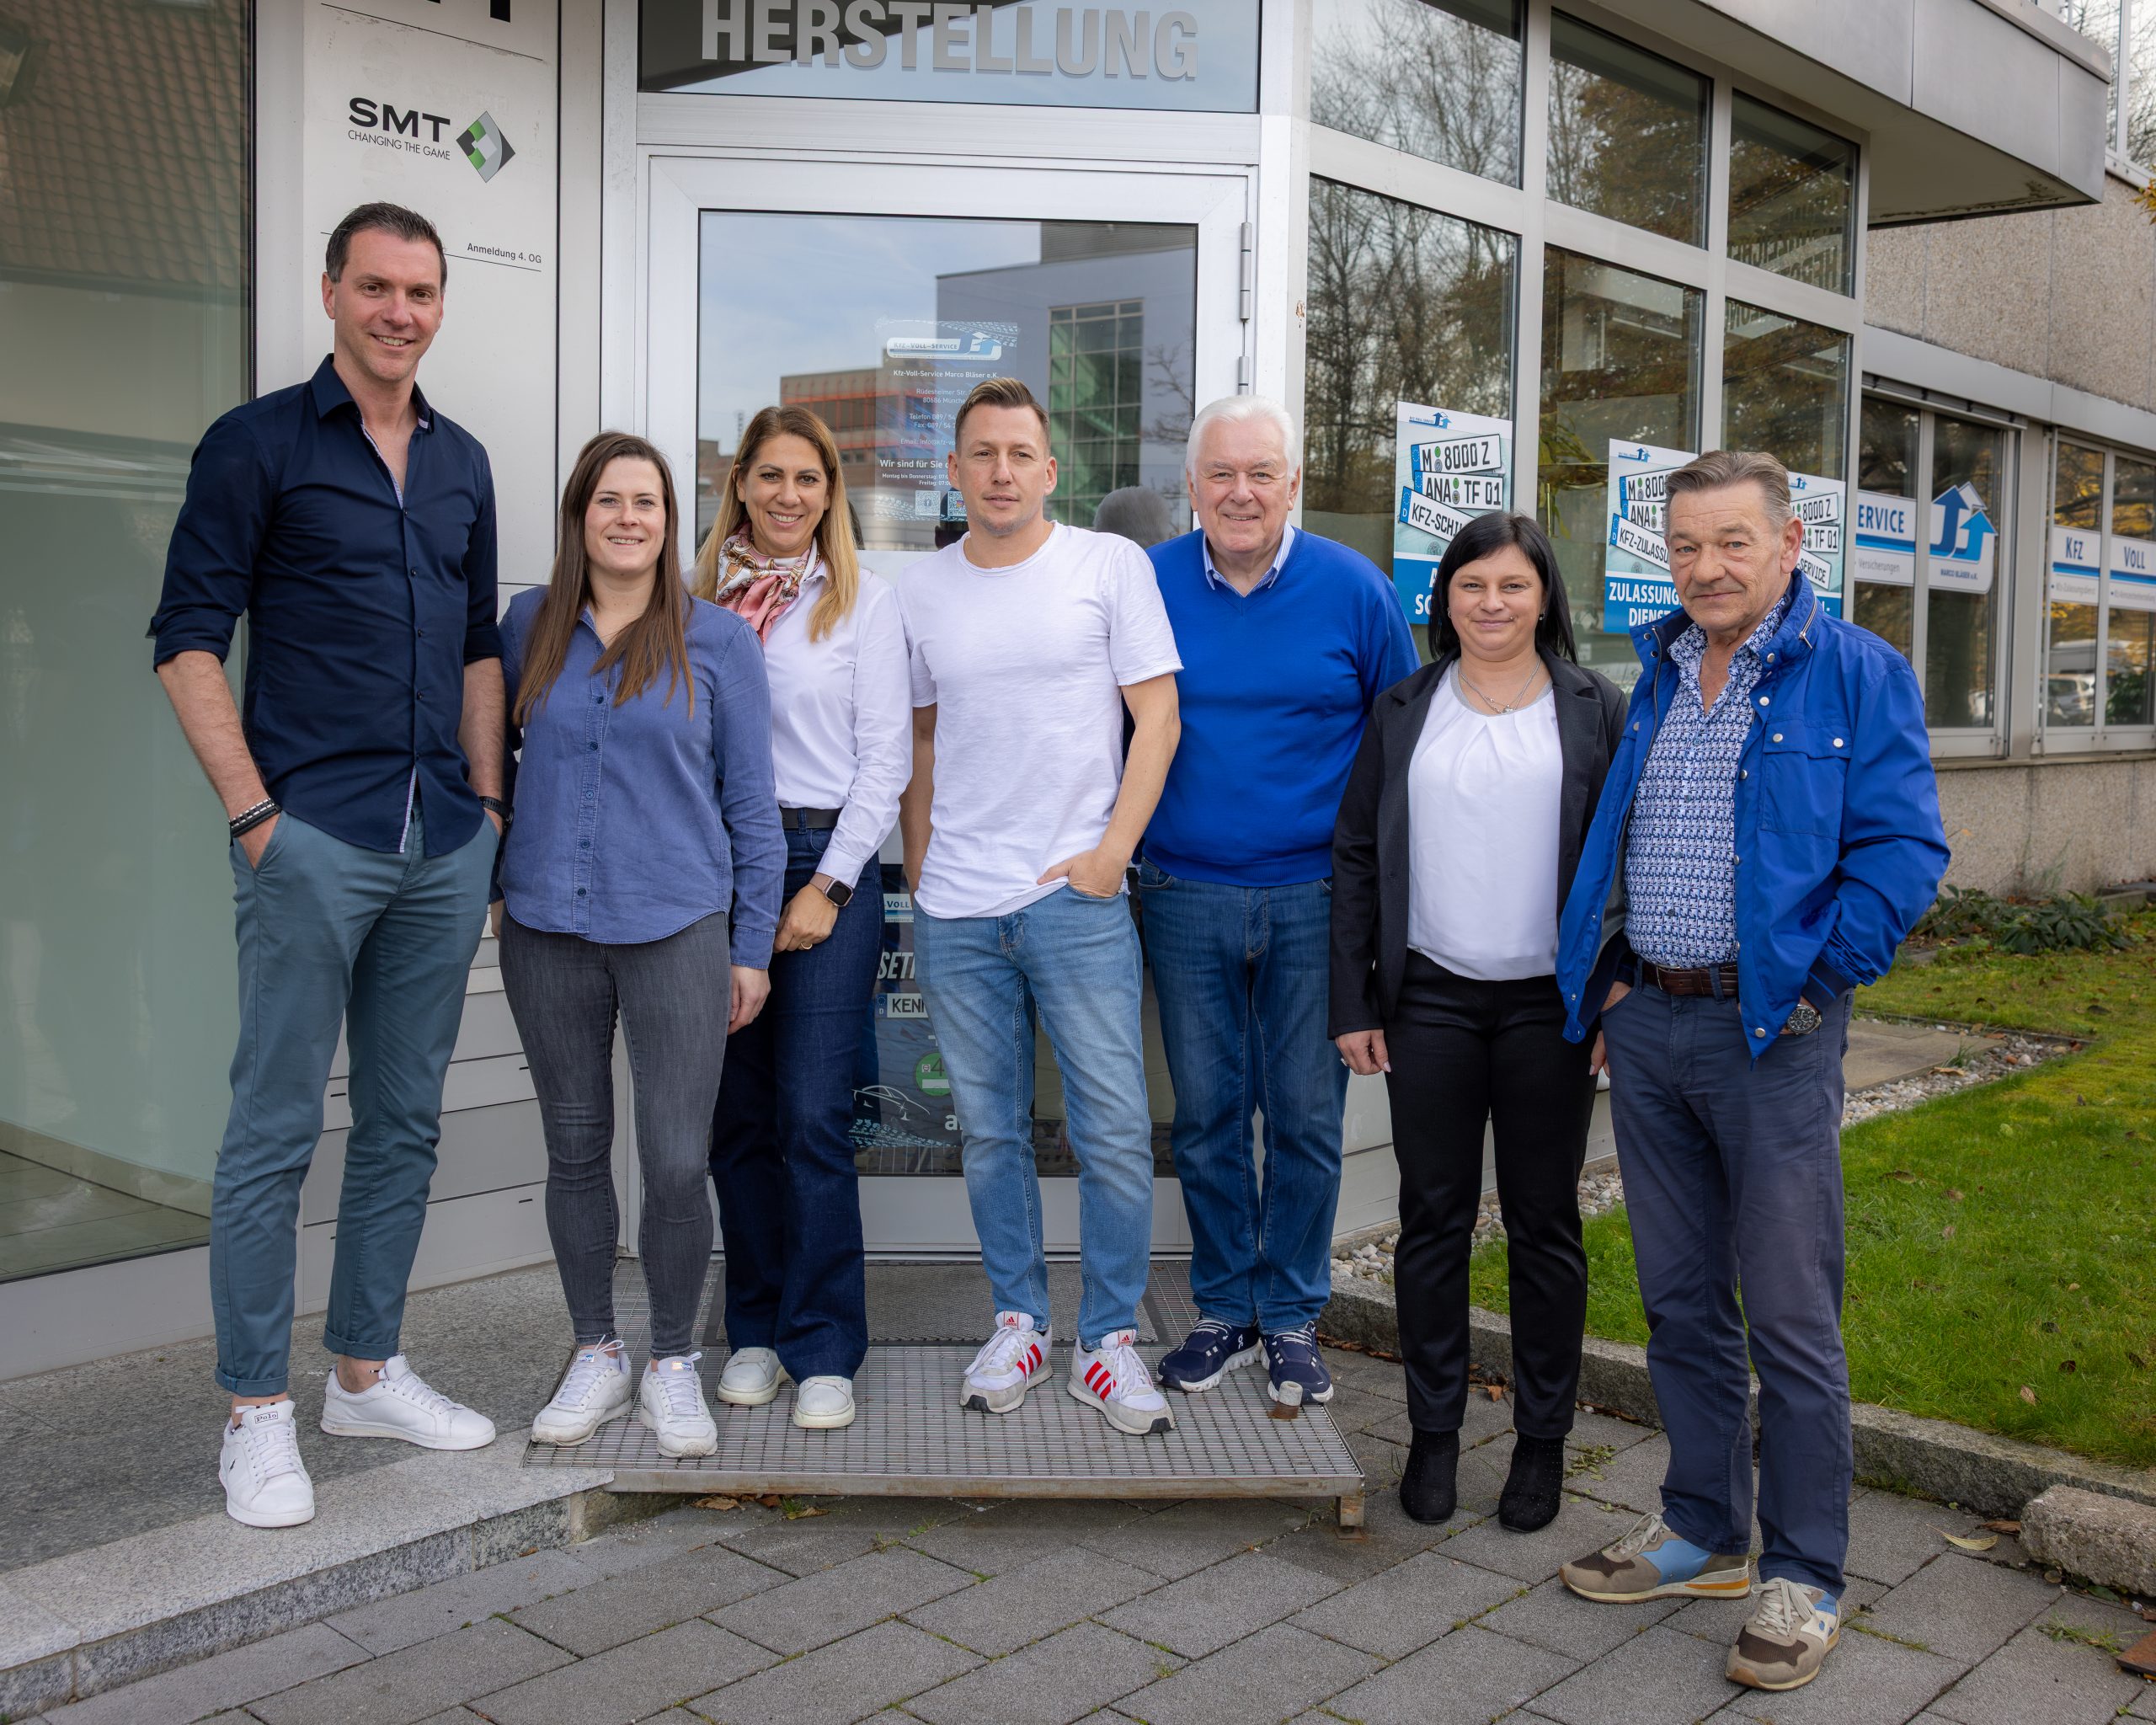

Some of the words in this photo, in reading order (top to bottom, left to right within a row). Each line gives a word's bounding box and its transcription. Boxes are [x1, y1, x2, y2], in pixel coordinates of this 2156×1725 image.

[702, 0, 1198, 81] HERSTELLUNG
[349, 97, 451, 142] SMT
[348, 130, 403, 150] CHANGING
[404, 141, 420, 154] THE
[423, 146, 451, 160] GAME
[467, 243, 515, 260] Anmeldung
[518, 252, 526, 261] 4.
[528, 254, 542, 264] OG
[879, 459, 895, 467] Wir
[897, 459, 914, 467] sind
[1422, 449, 1432, 472] M
[1444, 442, 1478, 471] 8000
[1481, 441, 1491, 465] Z
[1426, 478, 1452, 503] ANA
[1464, 479, 1481, 505] TF
[1485, 481, 1502, 505] 01
[1627, 479, 1636, 500] M
[1645, 474, 1668, 499] 800
[1402, 508, 1407, 517] D
[1412, 503, 1463, 537] KFZ-SCHI
[1630, 505, 1651, 527] ANA
[1802, 499, 1823, 522] 8000
[1826, 498, 1832, 518] Z
[1858, 504, 1905, 533] ERVICE
[1619, 526, 1670, 563] KFZ-ZULASSU
[1815, 530, 1825, 548] TF
[1828, 530, 1838, 549] 01
[1859, 558, 1900, 574] Versicherungen
[1609, 581, 1682, 606] ZULASSUNG
[1629, 607, 1671, 627] DIEN
[931, 1058, 945, 1077] 4
[256, 1413, 277, 1422] Polo
